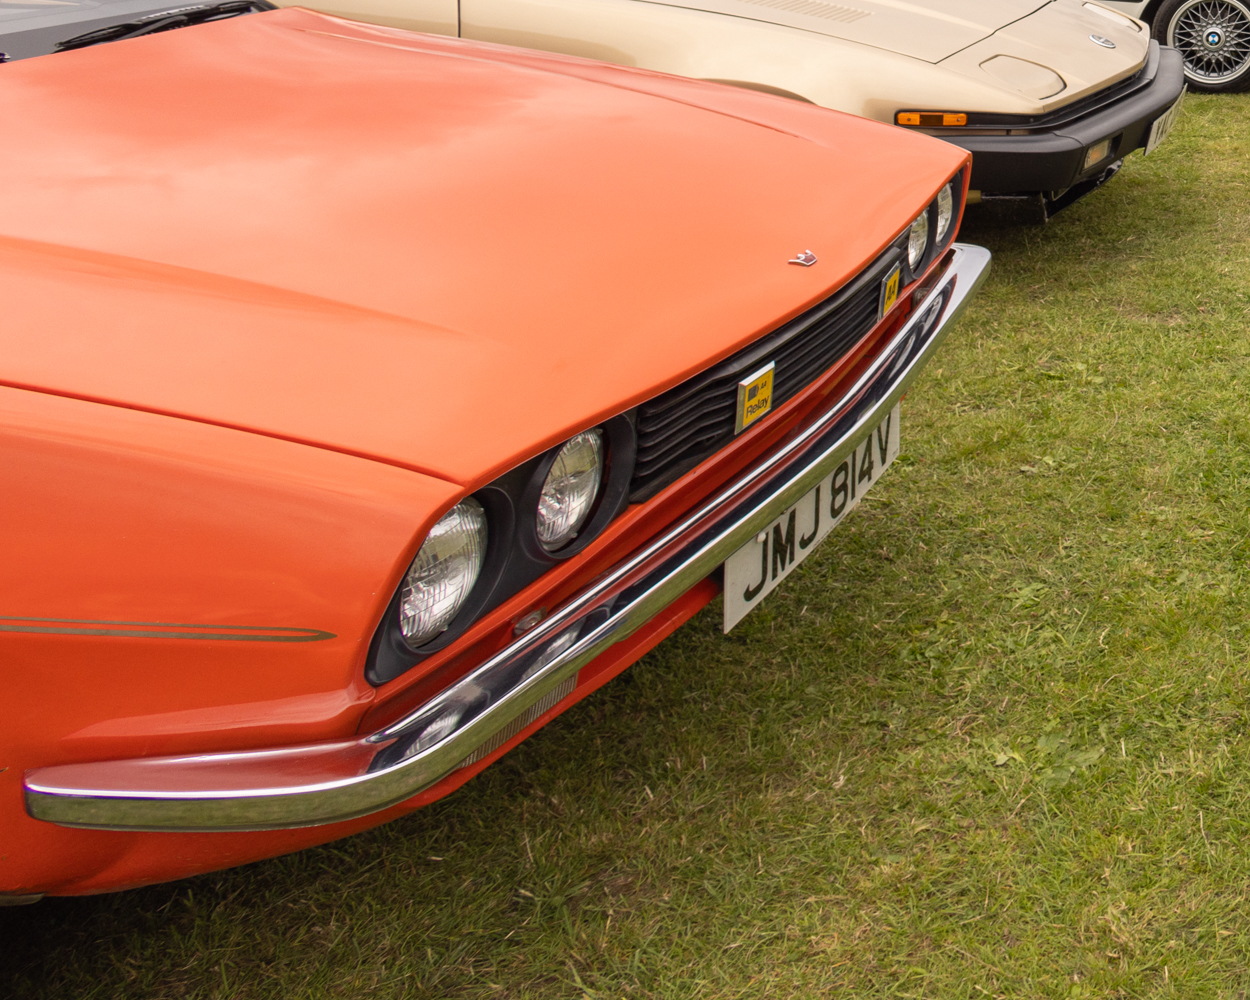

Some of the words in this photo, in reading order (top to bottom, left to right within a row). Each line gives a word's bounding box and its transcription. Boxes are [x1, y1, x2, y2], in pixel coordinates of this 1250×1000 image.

[886, 279, 897, 305] AA
[746, 395, 770, 418] Relay
[743, 484, 820, 602] JMJ
[830, 411, 892, 519] 814V
